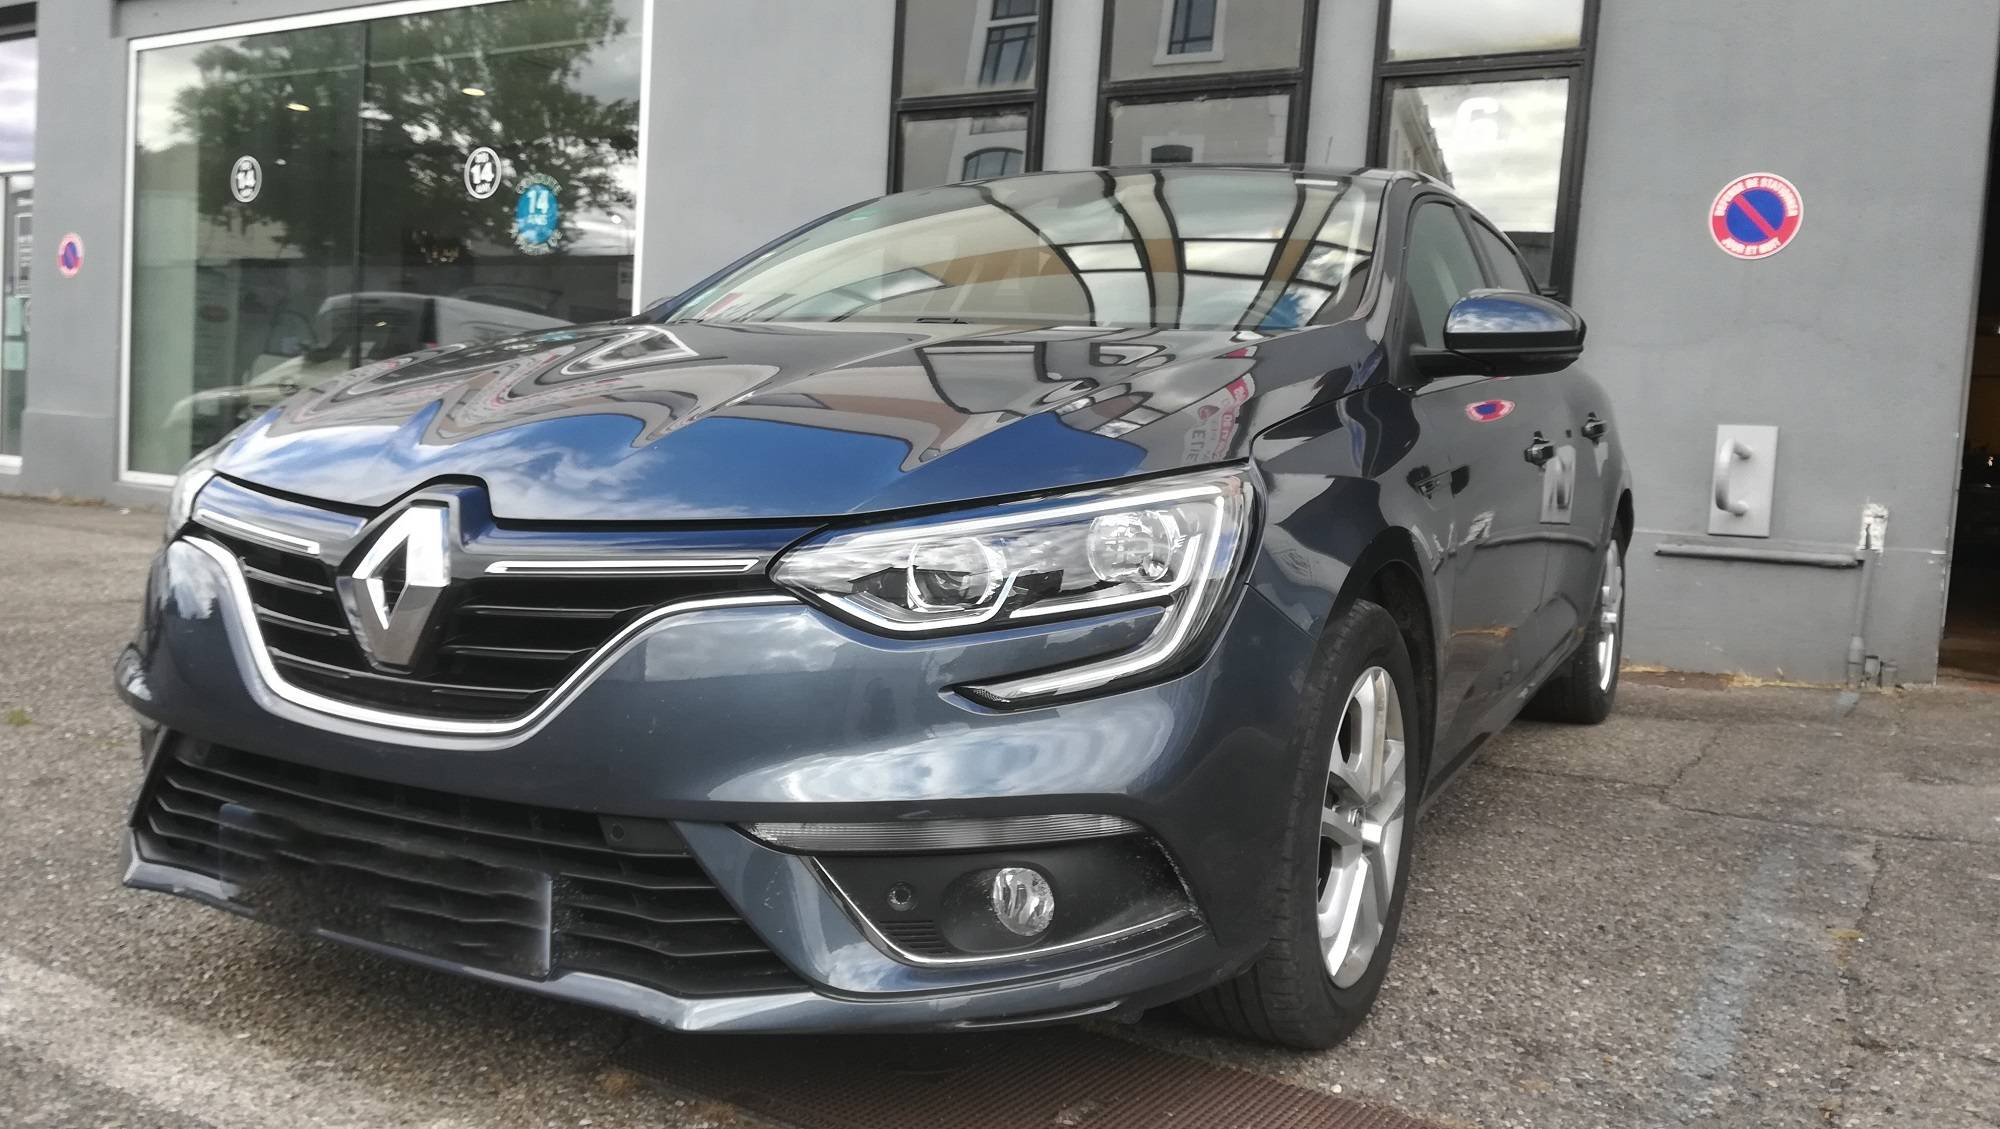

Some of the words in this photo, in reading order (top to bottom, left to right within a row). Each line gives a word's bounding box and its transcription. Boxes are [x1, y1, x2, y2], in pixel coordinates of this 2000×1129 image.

[237, 170, 256, 189] 14
[471, 162, 494, 185] 14
[527, 190, 549, 214] 14
[1744, 244, 1757, 255] ET
